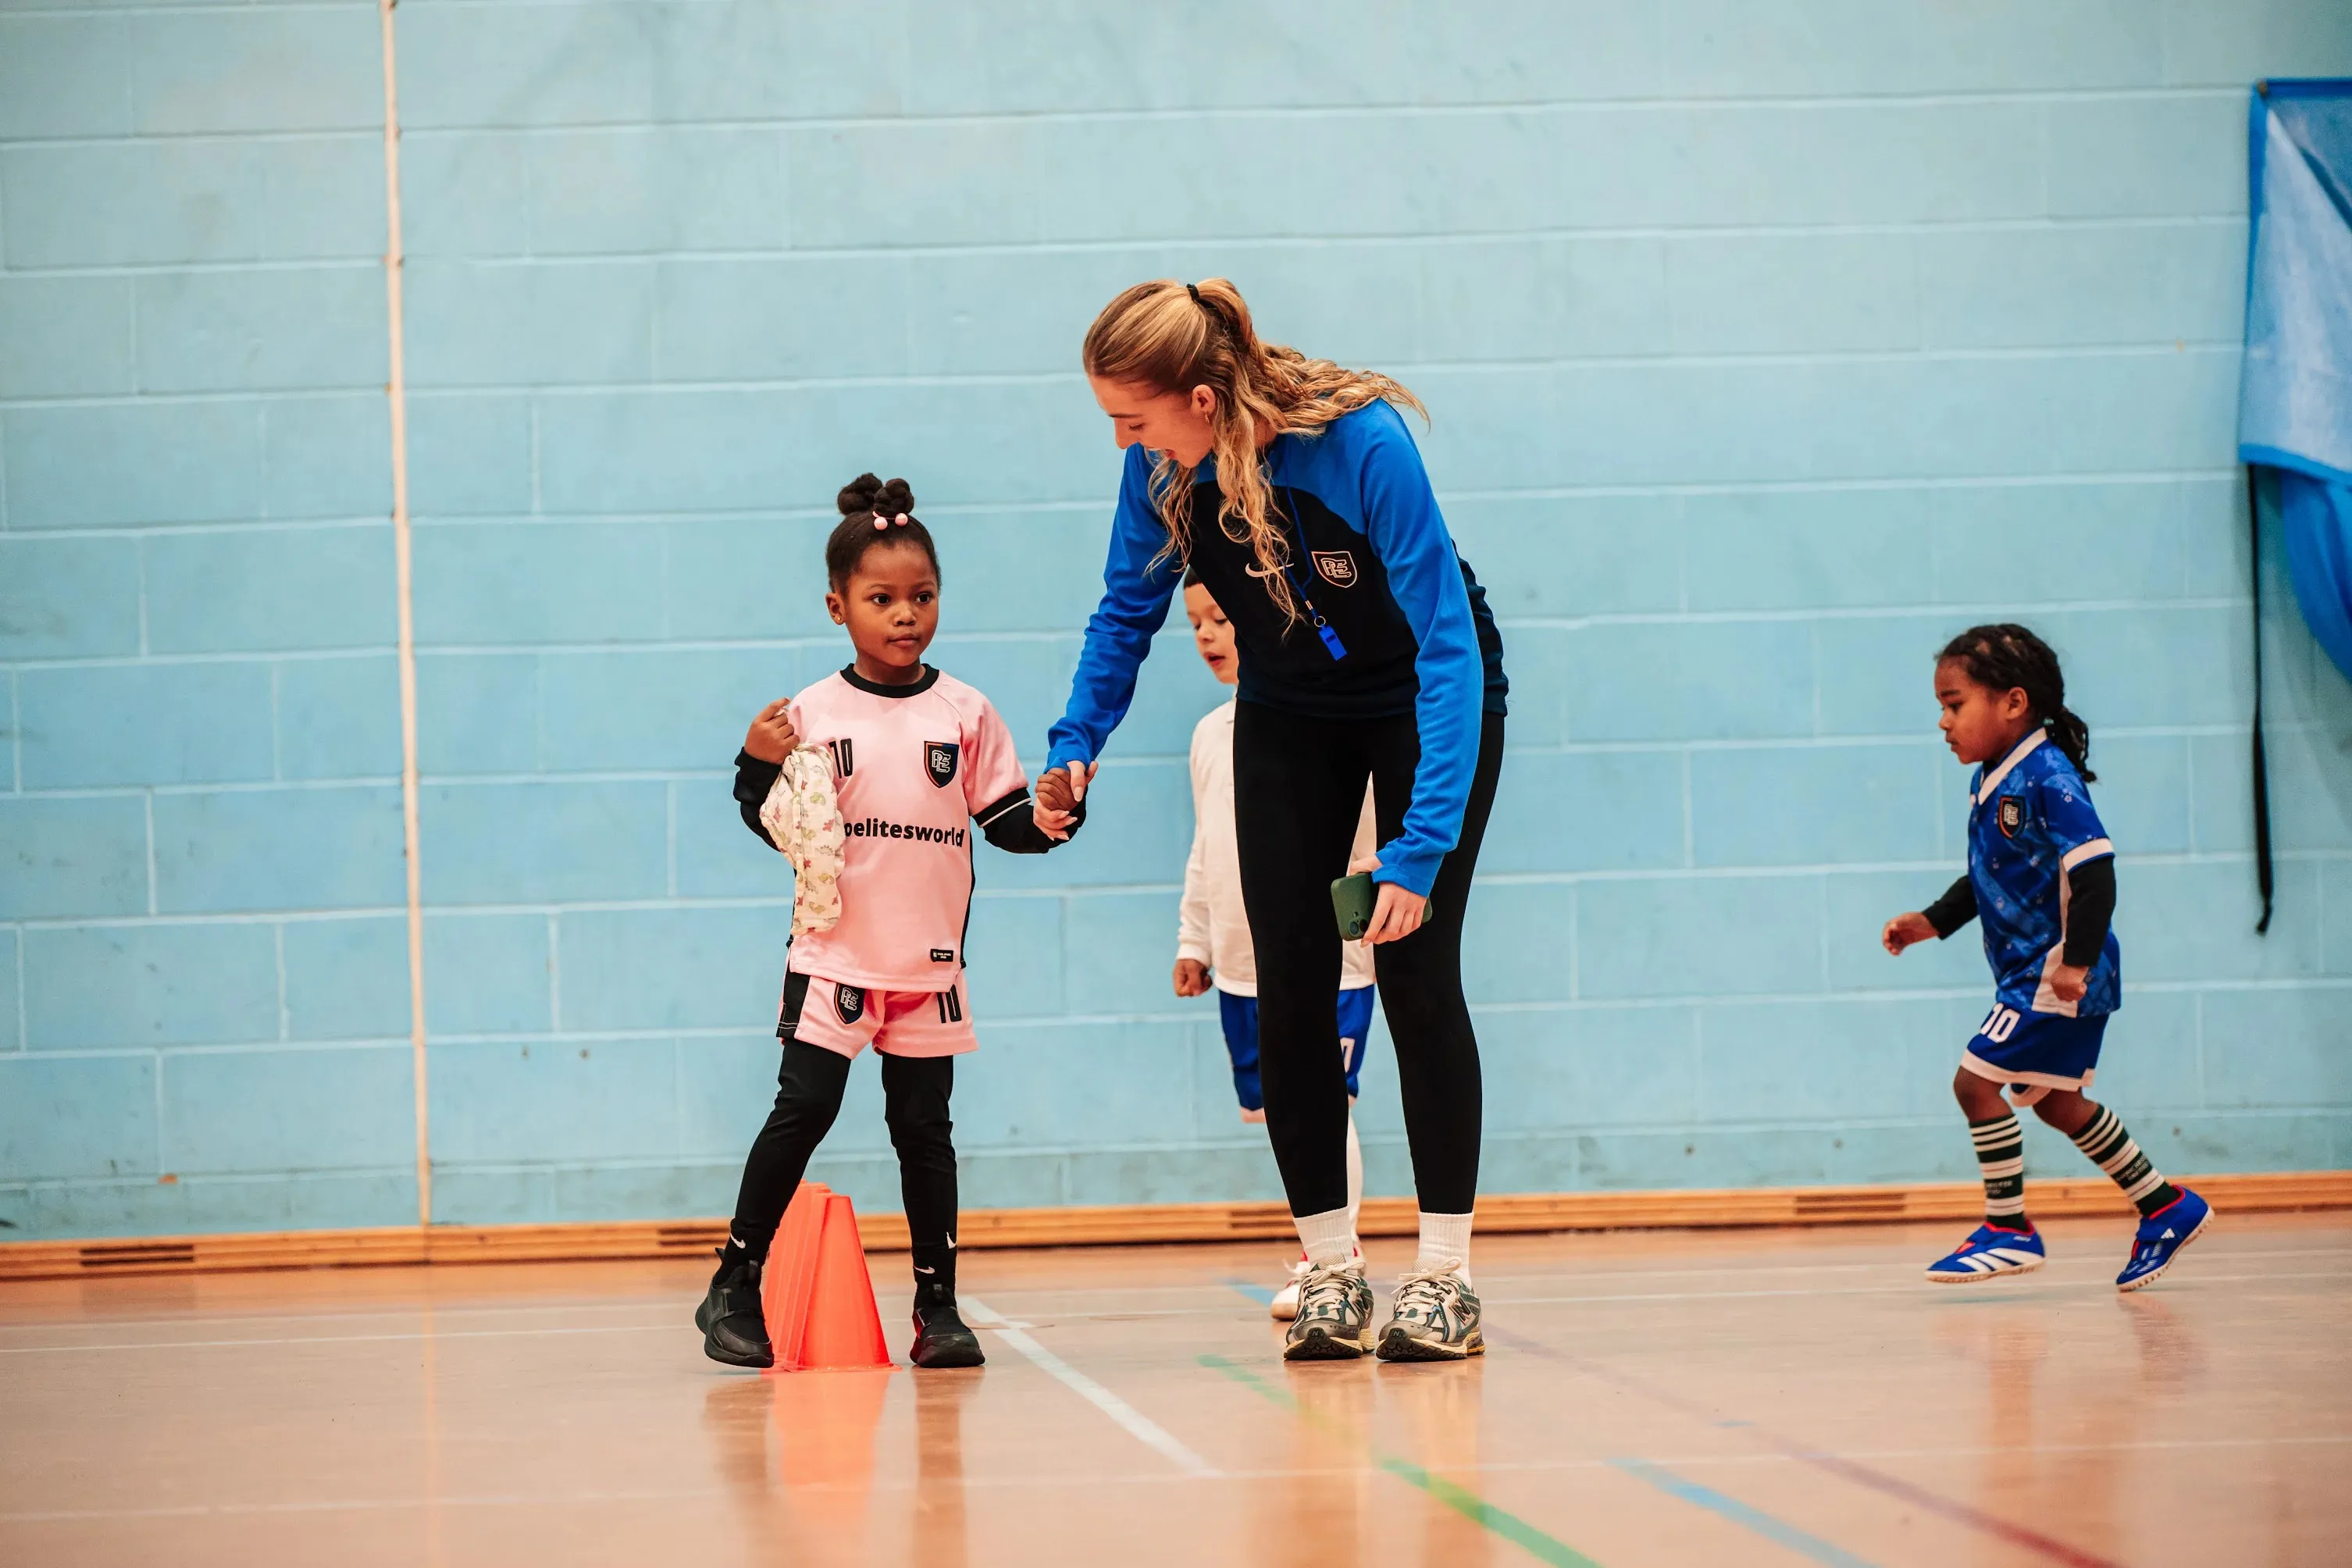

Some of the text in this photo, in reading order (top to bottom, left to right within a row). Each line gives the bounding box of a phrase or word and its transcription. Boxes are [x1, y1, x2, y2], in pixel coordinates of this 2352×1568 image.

[828, 738, 853, 779] 10
[936, 984, 962, 1024] 10
[1980, 1002, 2021, 1043] 10
